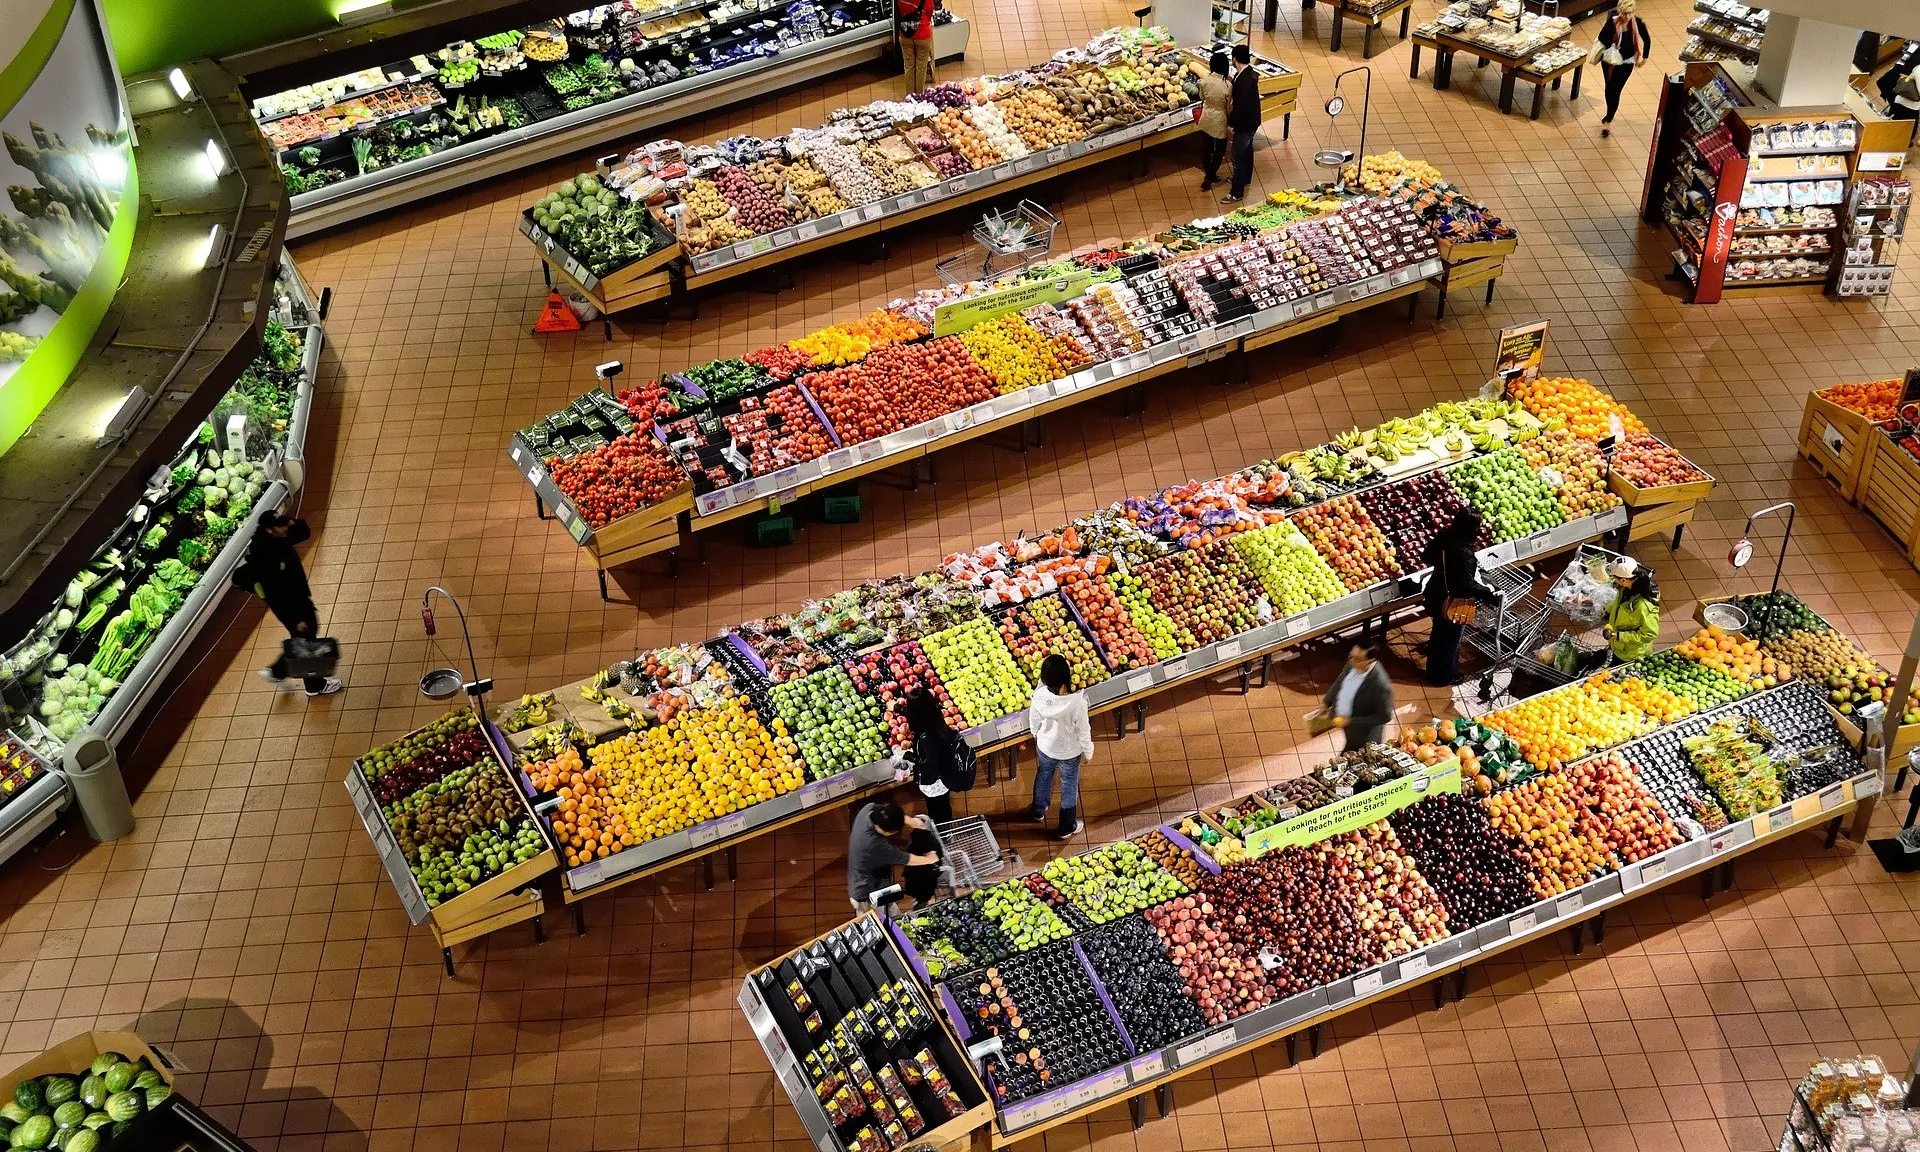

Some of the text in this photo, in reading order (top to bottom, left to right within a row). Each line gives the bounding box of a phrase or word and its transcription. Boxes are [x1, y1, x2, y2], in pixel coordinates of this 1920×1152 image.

[1714, 202, 1733, 263] Vachon
[963, 299, 987, 311] Looking
[987, 296, 997, 306] for
[997, 290, 1026, 302] nutritious
[1027, 283, 1053, 295] choices?
[978, 292, 1038, 312] Reach for the Stars!
[1285, 817, 1318, 834] Looking
[1319, 811, 1332, 822] for
[1332, 797, 1373, 816] nutritious
[1374, 782, 1408, 802] choices?
[1308, 798, 1388, 834] Reach for the Stars!
